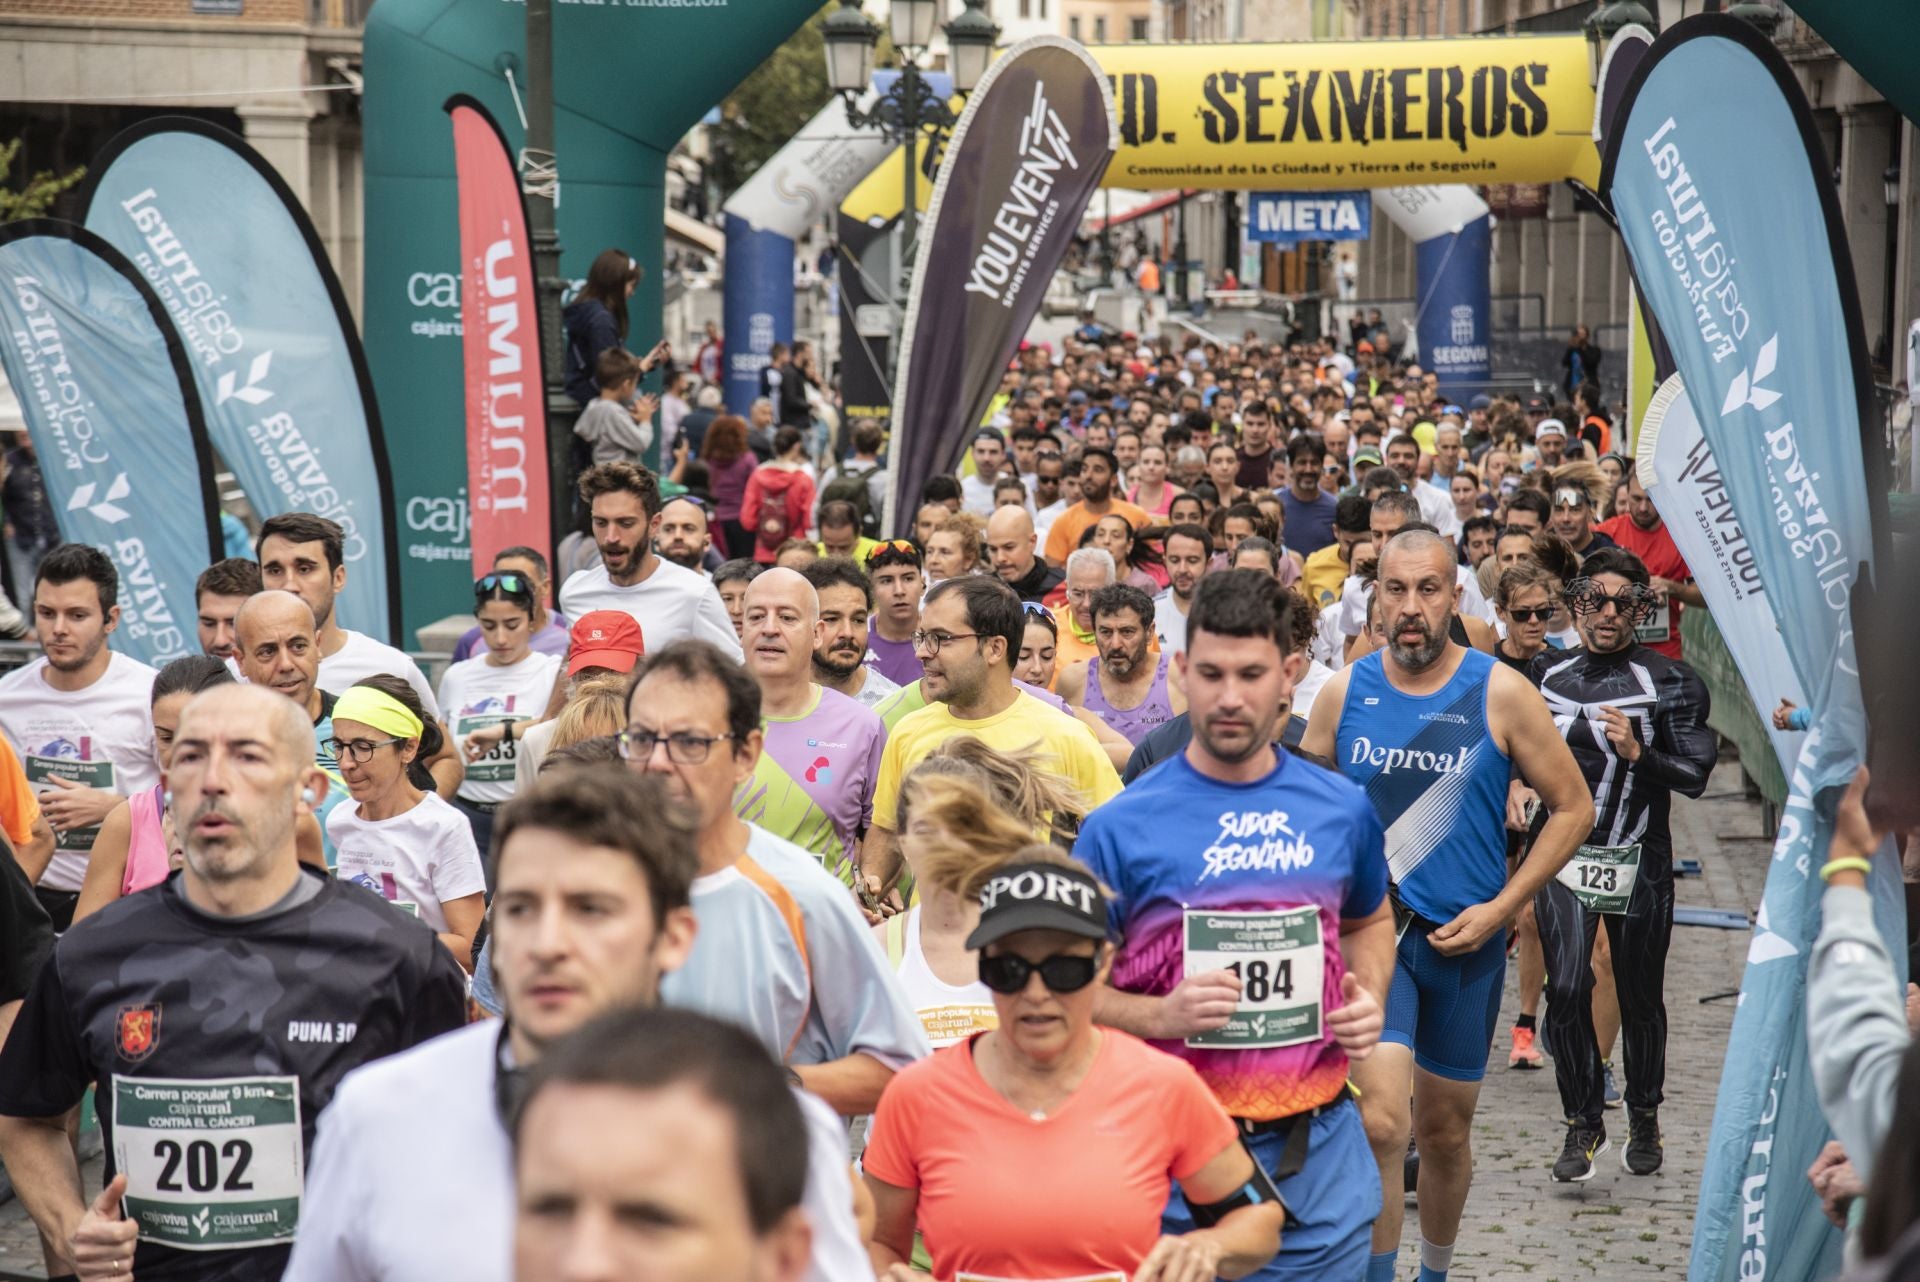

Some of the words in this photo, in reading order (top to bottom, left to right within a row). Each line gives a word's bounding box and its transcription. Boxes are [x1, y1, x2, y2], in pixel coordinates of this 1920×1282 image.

[1109, 73, 1176, 147] D.
[1197, 61, 1548, 151] SEXMEROS
[1127, 163, 1223, 176] Comunidad
[1230, 163, 1252, 174] de
[1254, 163, 1269, 174] la
[1273, 162, 1330, 175] Ciudad
[1334, 165, 1346, 176] y
[1350, 161, 1400, 173] Tierra
[1405, 160, 1426, 172] de
[1430, 158, 1497, 173] Segovia
[1259, 200, 1361, 232] META
[1002, 256, 1031, 308] SPORTS
[1025, 198, 1060, 260] SERVICES
[1350, 736, 1469, 775] Deproal
[1214, 809, 1298, 845] SUDOR
[1195, 831, 1315, 886] SEGOVIANO
[980, 870, 1097, 914] SPORT
[1578, 864, 1617, 892] 123
[288, 1021, 332, 1043] PUMA
[135, 1086, 178, 1100] Carrera
[182, 1086, 229, 1103] popular
[233, 1086, 241, 1099] 9
[168, 1101, 232, 1117] cajarural
[148, 1117, 193, 1128] CONTRA
[194, 1117, 207, 1128] EL
[208, 1115, 255, 1128] CÁNCER
[154, 1139, 254, 1192] 202
[142, 1209, 189, 1229] cajaviva
[213, 1208, 279, 1227] cajarural
[214, 1225, 258, 1235] Fundación
